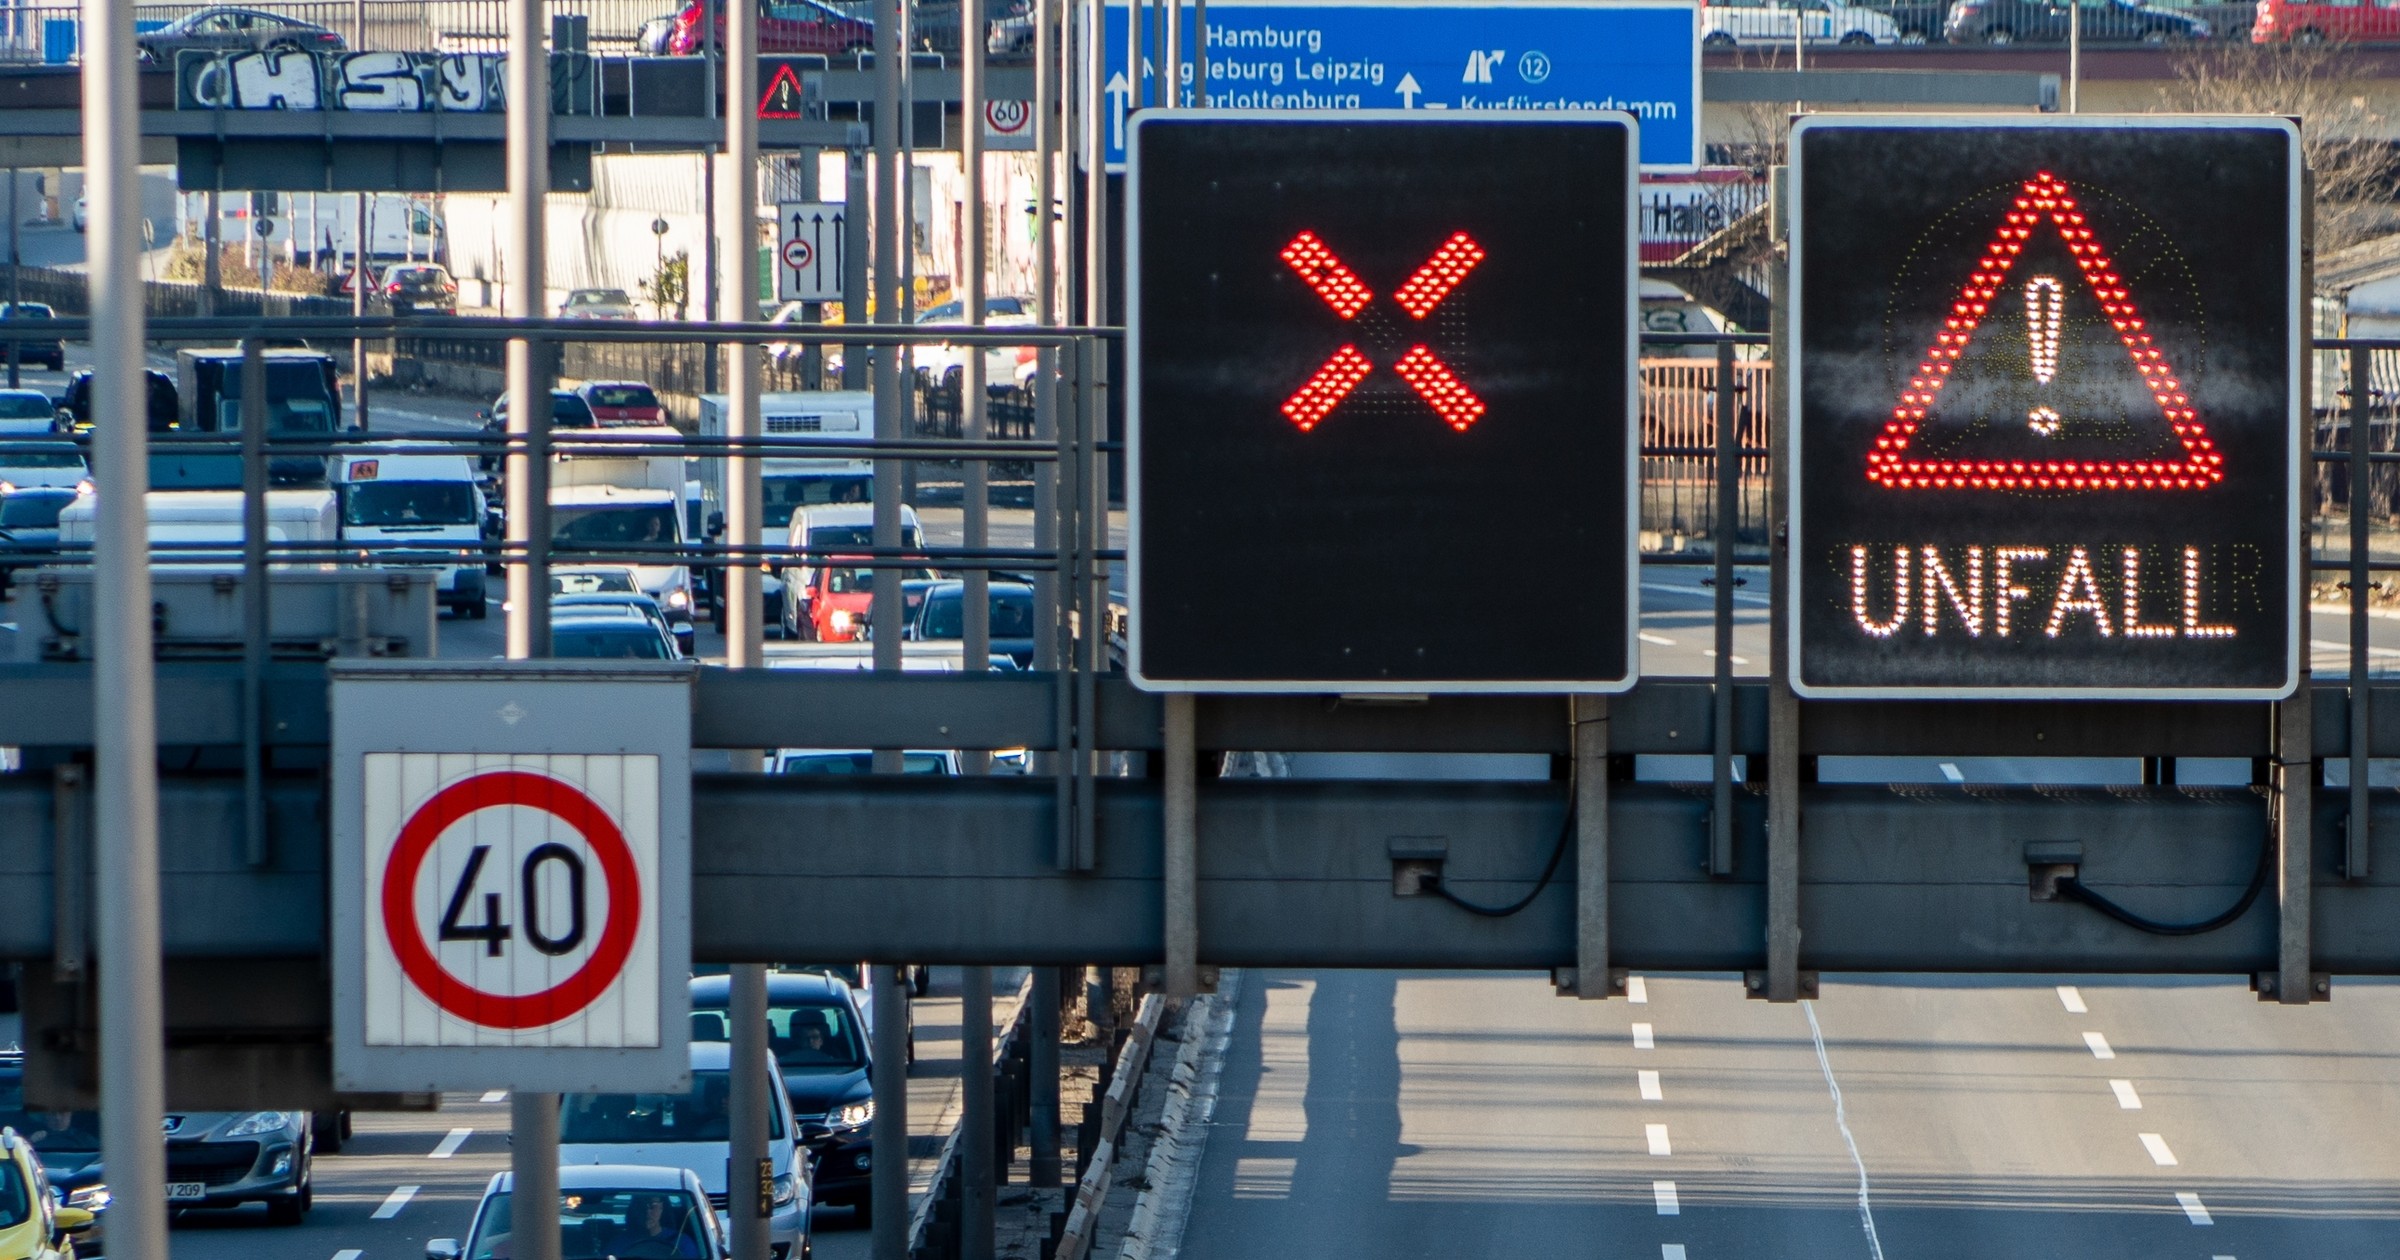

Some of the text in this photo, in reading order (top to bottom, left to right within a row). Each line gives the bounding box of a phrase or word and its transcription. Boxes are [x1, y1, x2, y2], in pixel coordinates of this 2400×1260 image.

[1205, 24, 1322, 54] Hamburg
[1295, 57, 1384, 86] Leipzig
[1525, 58, 1543, 77] 12
[995, 100, 1020, 122] 60
[1850, 543, 2238, 639] UNFALL
[439, 841, 586, 958] 40
[177, 1184, 201, 1197] 209
